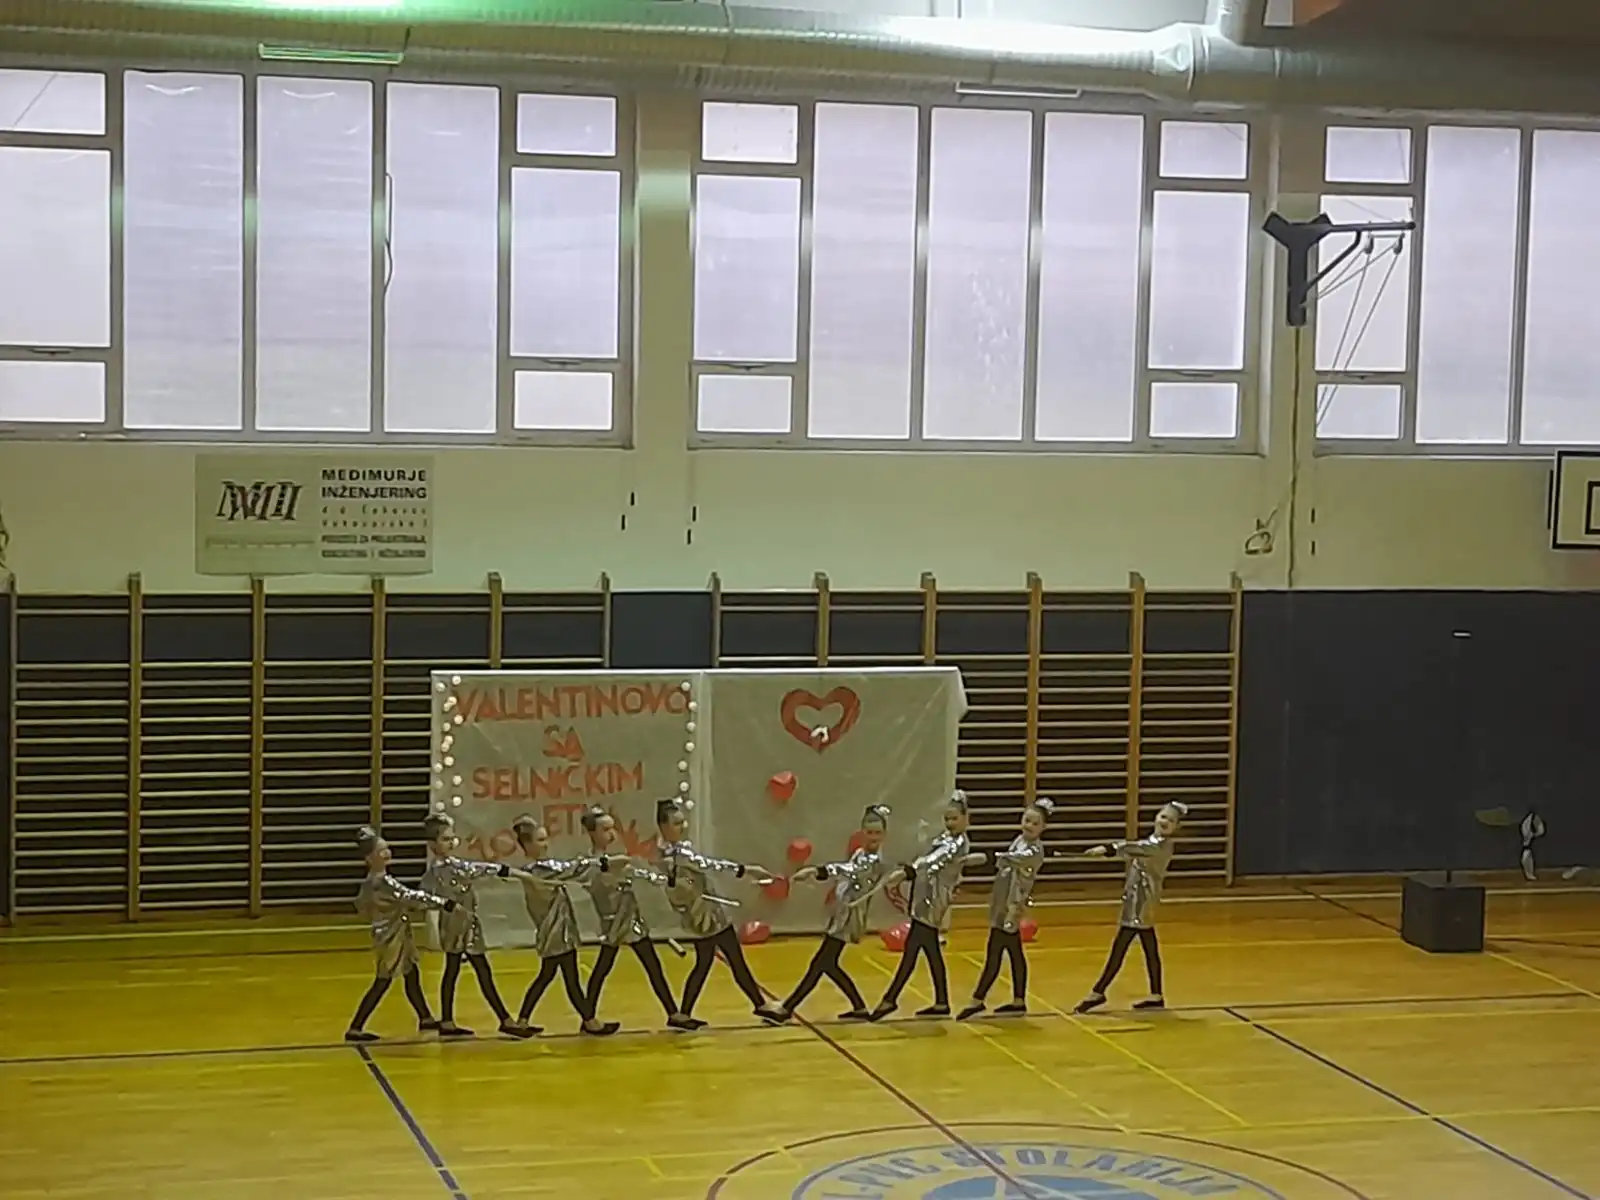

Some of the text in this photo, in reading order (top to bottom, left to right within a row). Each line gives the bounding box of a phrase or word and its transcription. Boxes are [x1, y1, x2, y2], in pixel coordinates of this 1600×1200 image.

[321, 485, 427, 498] INŽENJERING
[453, 683, 690, 723] VALENTINOVO
[542, 724, 585, 761] SA
